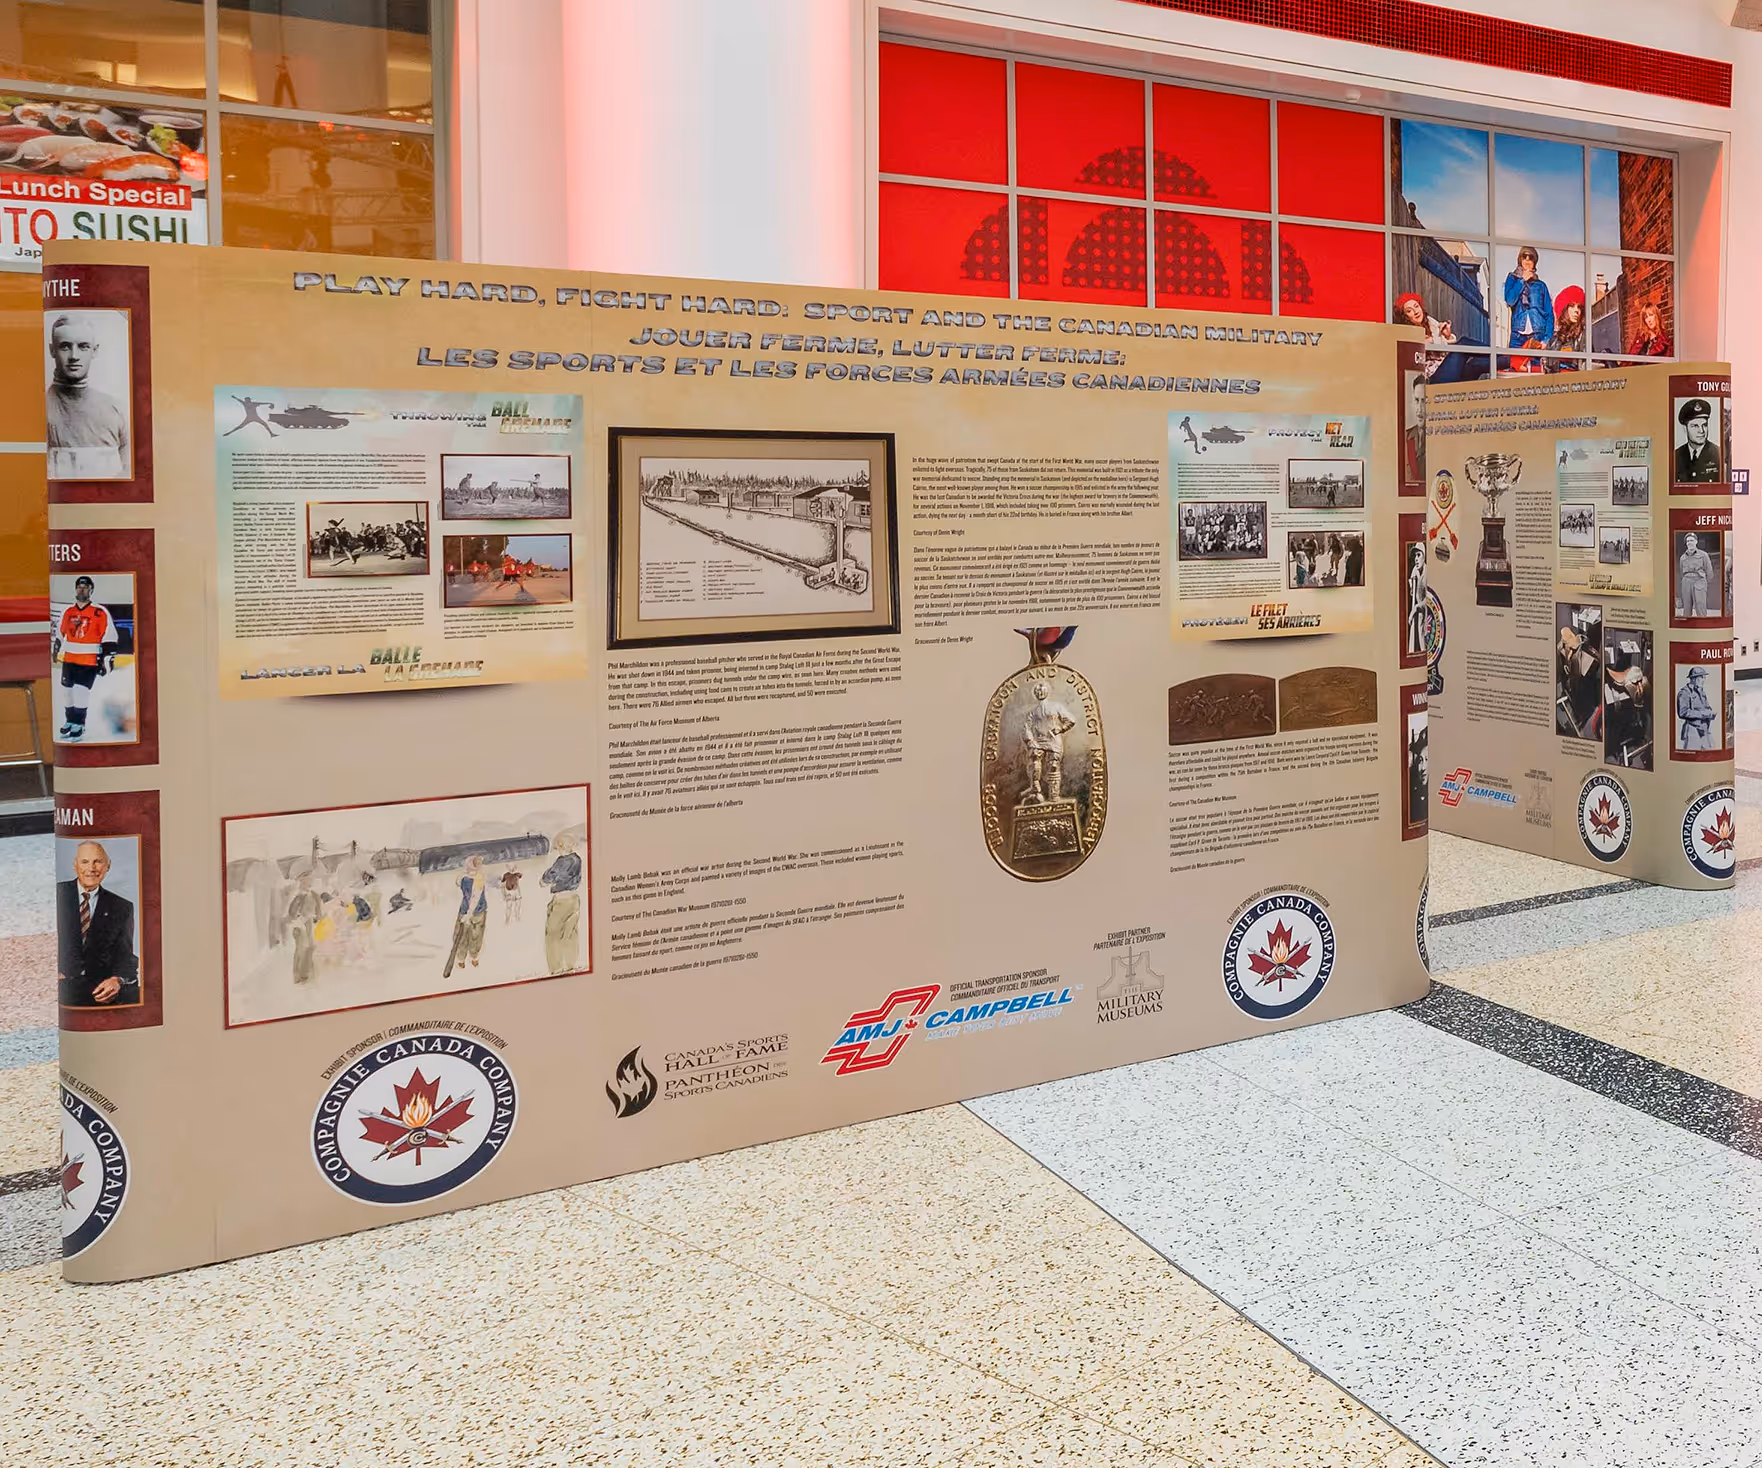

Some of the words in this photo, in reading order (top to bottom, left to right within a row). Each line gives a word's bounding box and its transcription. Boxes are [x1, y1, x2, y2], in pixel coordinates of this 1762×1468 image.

[0, 177, 80, 200] Lunch
[89, 182, 185, 206] Special
[0, 207, 58, 245] TO
[73, 211, 188, 243] SUSHI
[294, 272, 410, 297] PLAY
[421, 279, 545, 307] HARD,
[556, 287, 671, 310] FIGHT
[682, 295, 789, 318] HARD:
[803, 303, 915, 324] SPORT
[920, 309, 986, 328] AND
[994, 313, 1052, 332] THE
[1058, 318, 1198, 340] CANADIAN
[1204, 327, 1324, 346] MILITARY
[629, 327, 752, 350] JOUER
[759, 332, 883, 360] FERME,
[892, 340, 1014, 362] LUTTER
[1021, 345, 1127, 366] FERME:
[416, 347, 499, 369] LES
[506, 349, 667, 375] SPORTS
[674, 357, 722, 376] ET
[729, 359, 797, 380] LES
[804, 362, 933, 384] FORCES
[939, 367, 1066, 389] ARMÉES
[1072, 373, 1261, 396] CANADIENNES
[1697, 381, 1720, 392] TONY
[1695, 516, 1716, 526] JEFF
[1263, 602, 1288, 616] FILET
[370, 646, 422, 665] BALLE
[1700, 648, 1722, 659] PAUL
[1026, 667, 1058, 682] AND
[658, 718, 672, 726] Force
[673, 717, 695, 725] Museum
[1441, 780, 1461, 793] AMJ
[1467, 785, 1516, 804] CAMPBELL
[1683, 800, 1706, 862] COMPAGNIE
[1225, 913, 1255, 1001] COMPAGNIE
[1256, 896, 1312, 914] CANADA
[1314, 912, 1334, 983] COMPANY
[1097, 989, 1164, 1012] MILITARY
[1097, 1001, 1163, 1024] MUSEUMS
[834, 1018, 902, 1046] AMJ
[925, 987, 1074, 1029] CAMPBELL
[321, 1055, 349, 1080] EXHIBIT
[347, 1033, 383, 1059] SPONSOR
[388, 1020, 454, 1038] COMMANDITAIRE
[454, 1022, 465, 1032] DE
[665, 1055, 719, 1073] HALL
[736, 1041, 789, 1060] FAME
[665, 1062, 770, 1091] PANTHÉON
[318, 1063, 371, 1183] COMPAGNIE
[376, 1037, 475, 1064] CANADA
[479, 1056, 513, 1150] COMPANY
[89, 1119, 123, 1225] COMPANY
